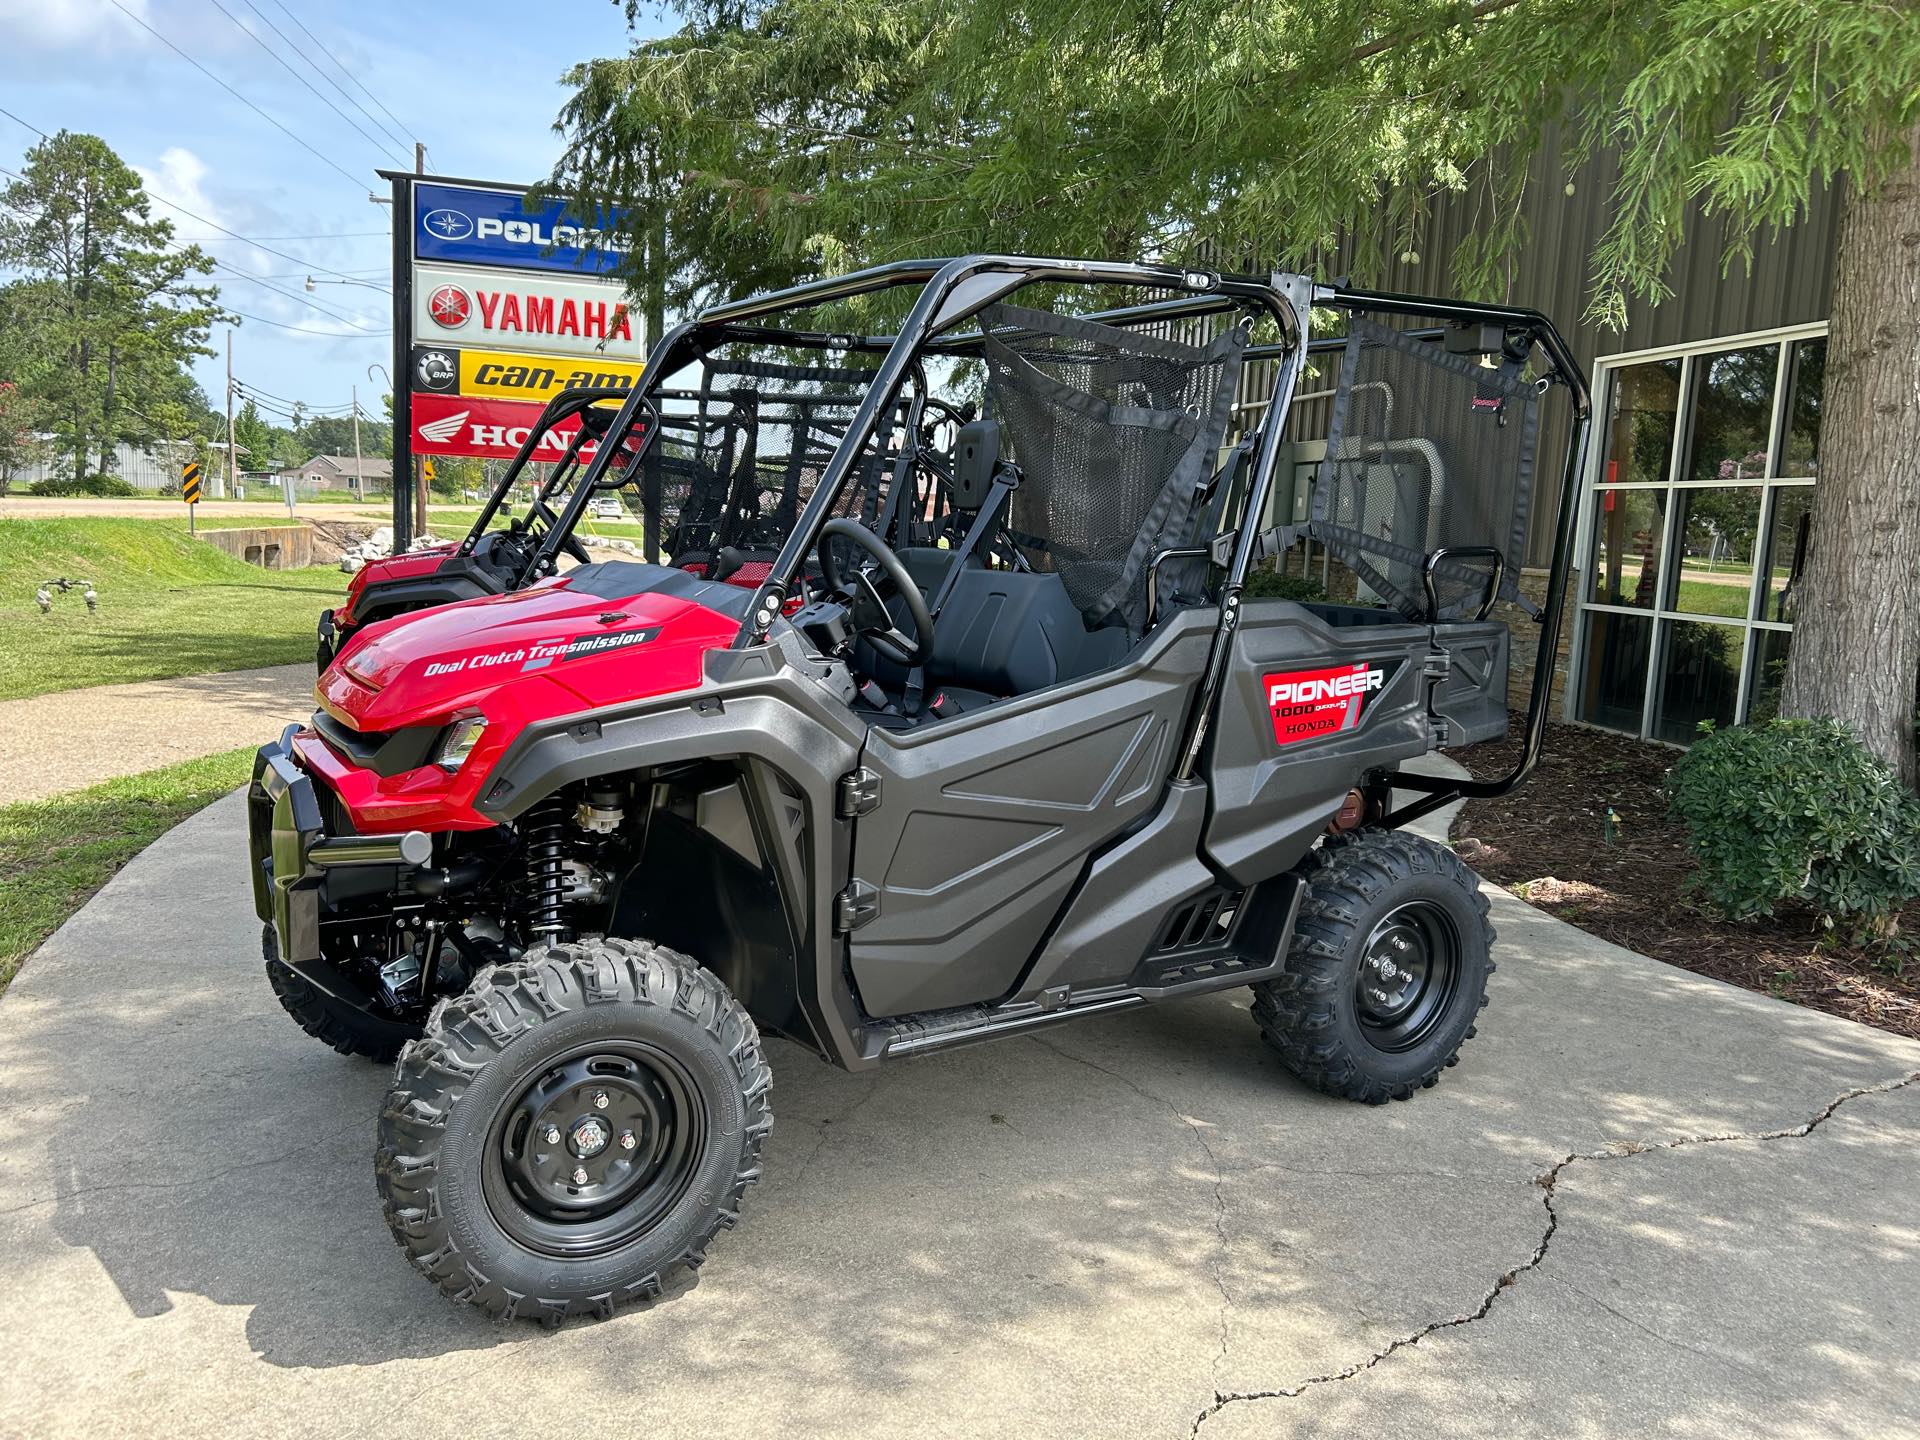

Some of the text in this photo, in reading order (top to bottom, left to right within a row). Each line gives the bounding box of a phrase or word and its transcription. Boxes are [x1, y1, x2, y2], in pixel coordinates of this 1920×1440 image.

[476, 290, 632, 341] YAMAHA
[433, 371, 454, 379] BRP
[423, 632, 646, 677] Dual Clutch Transmission
[1270, 669, 1383, 706] PIONEER
[1274, 703, 1315, 718] 1000
[1285, 718, 1337, 734] HONDA
